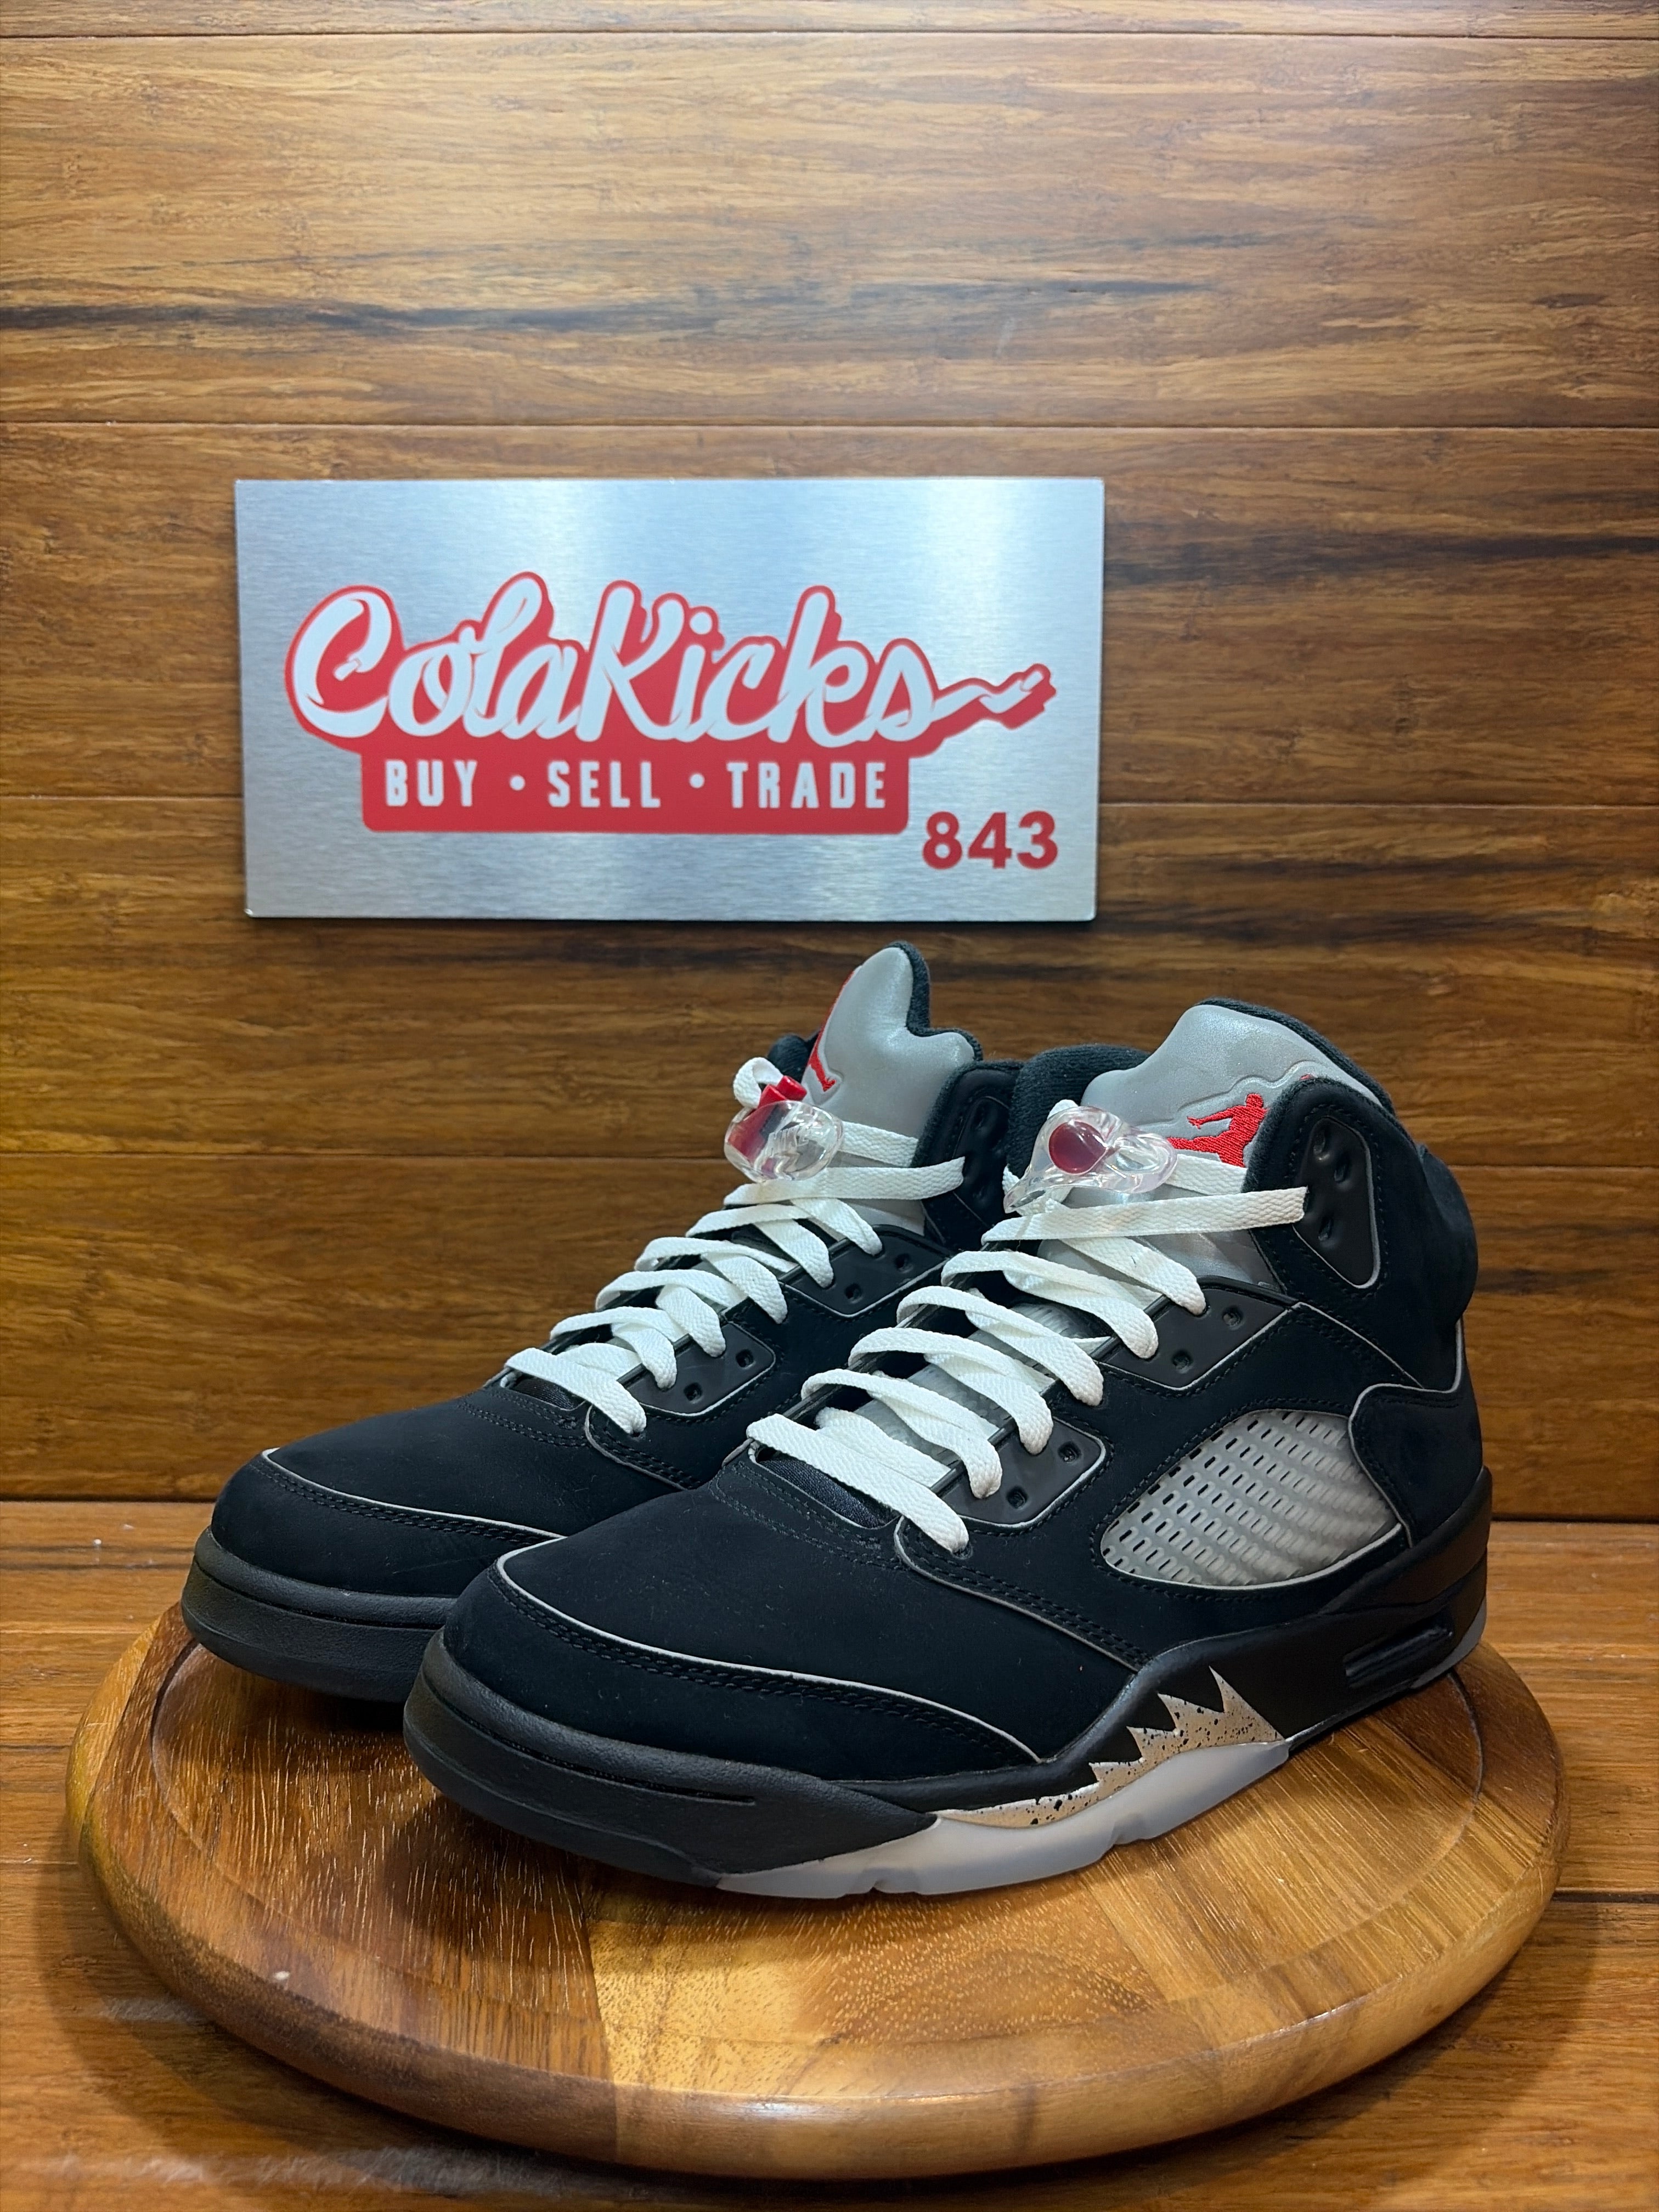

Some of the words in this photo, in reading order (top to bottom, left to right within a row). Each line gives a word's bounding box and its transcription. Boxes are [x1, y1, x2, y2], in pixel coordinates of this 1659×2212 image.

[385, 759, 477, 808] BUY
[548, 760, 661, 808] SELL
[726, 761, 885, 809] TRADE
[923, 812, 1057, 869] 843
